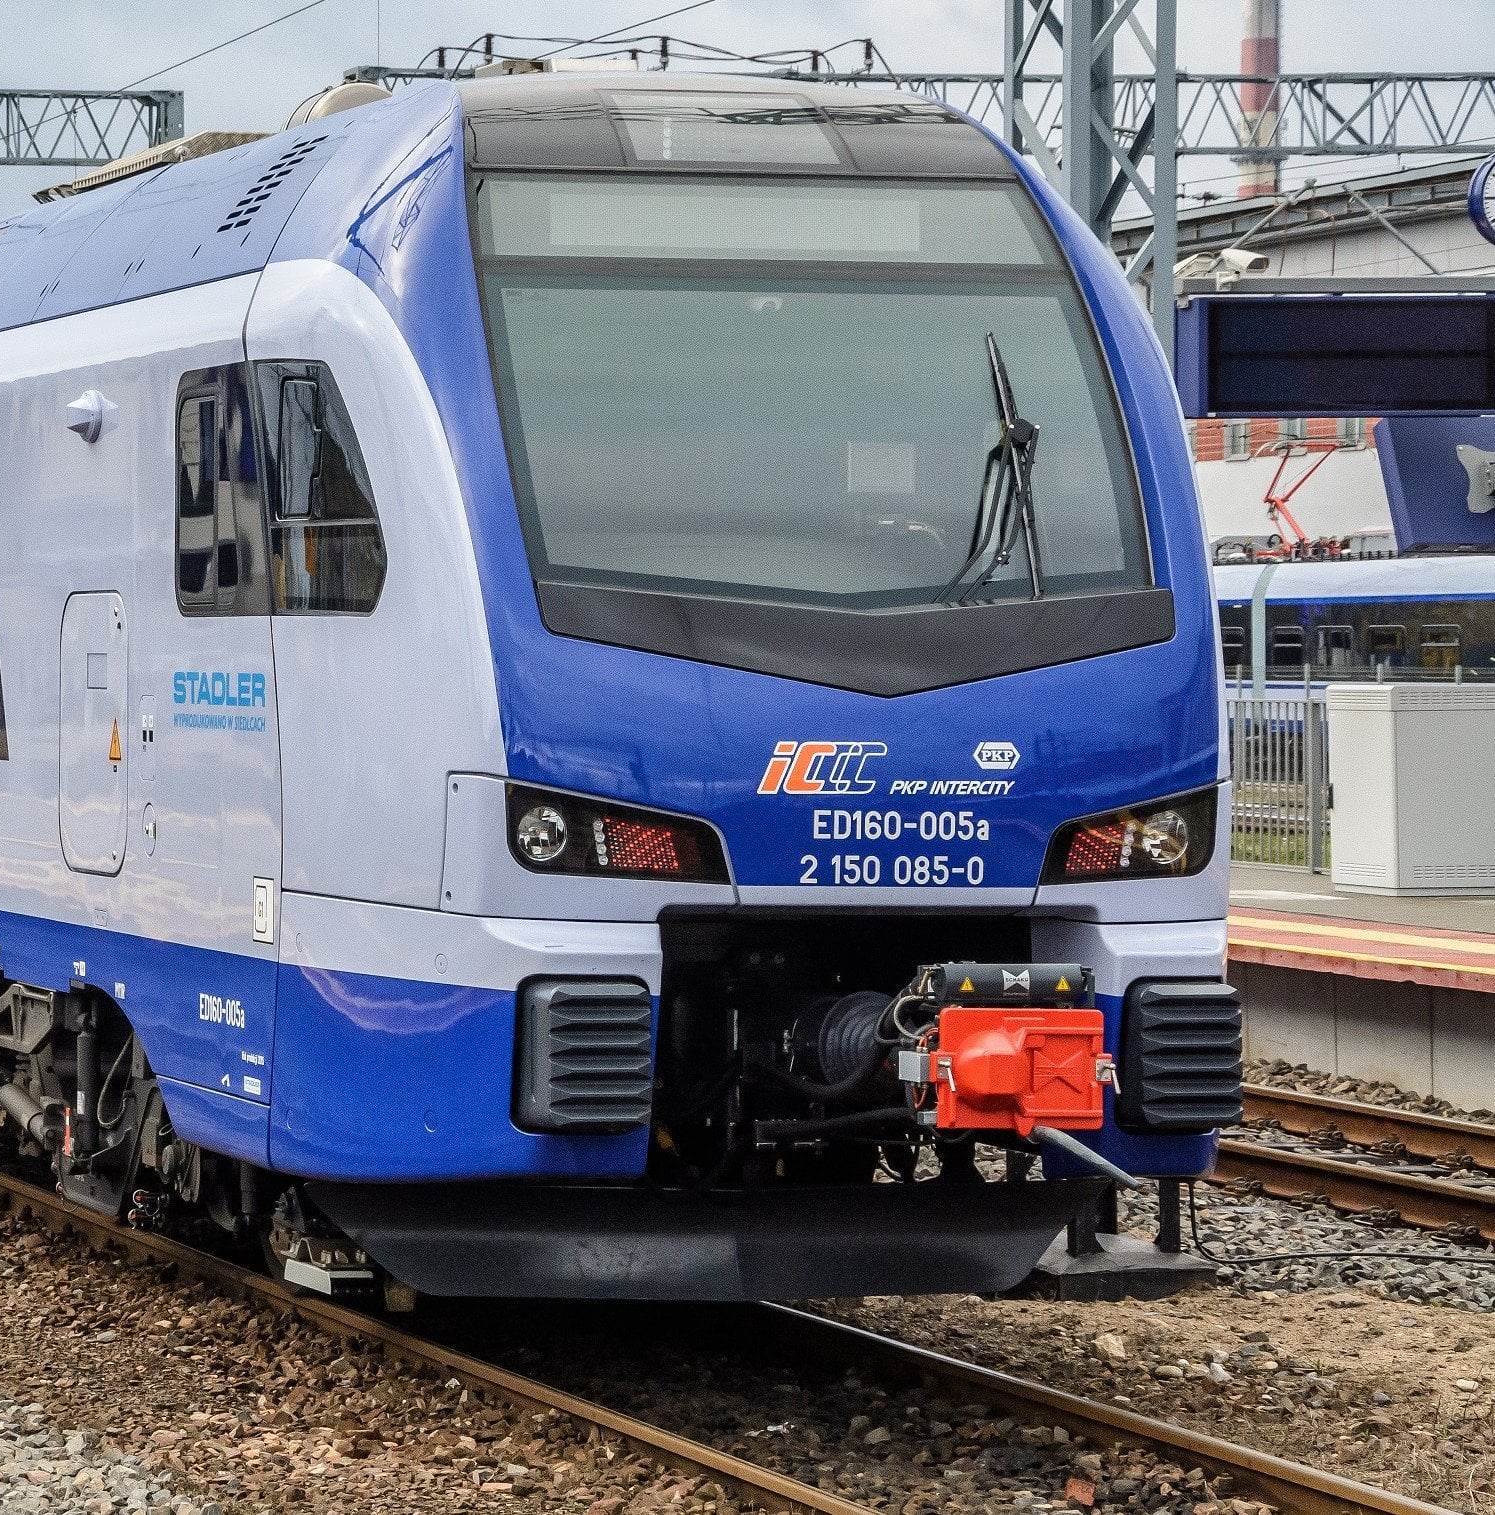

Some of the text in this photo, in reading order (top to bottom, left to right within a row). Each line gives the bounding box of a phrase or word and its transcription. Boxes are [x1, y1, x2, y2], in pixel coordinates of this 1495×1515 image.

[173, 671, 266, 708] STADLER
[234, 715, 266, 732] SIEDLCACH
[981, 750, 1015, 761] PKP
[889, 780, 1016, 795] PKP INTERCITY
[813, 809, 990, 841] ED160-005a
[799, 854, 984, 885] 2 150 085-0
[199, 992, 245, 1029] ED160-005a
